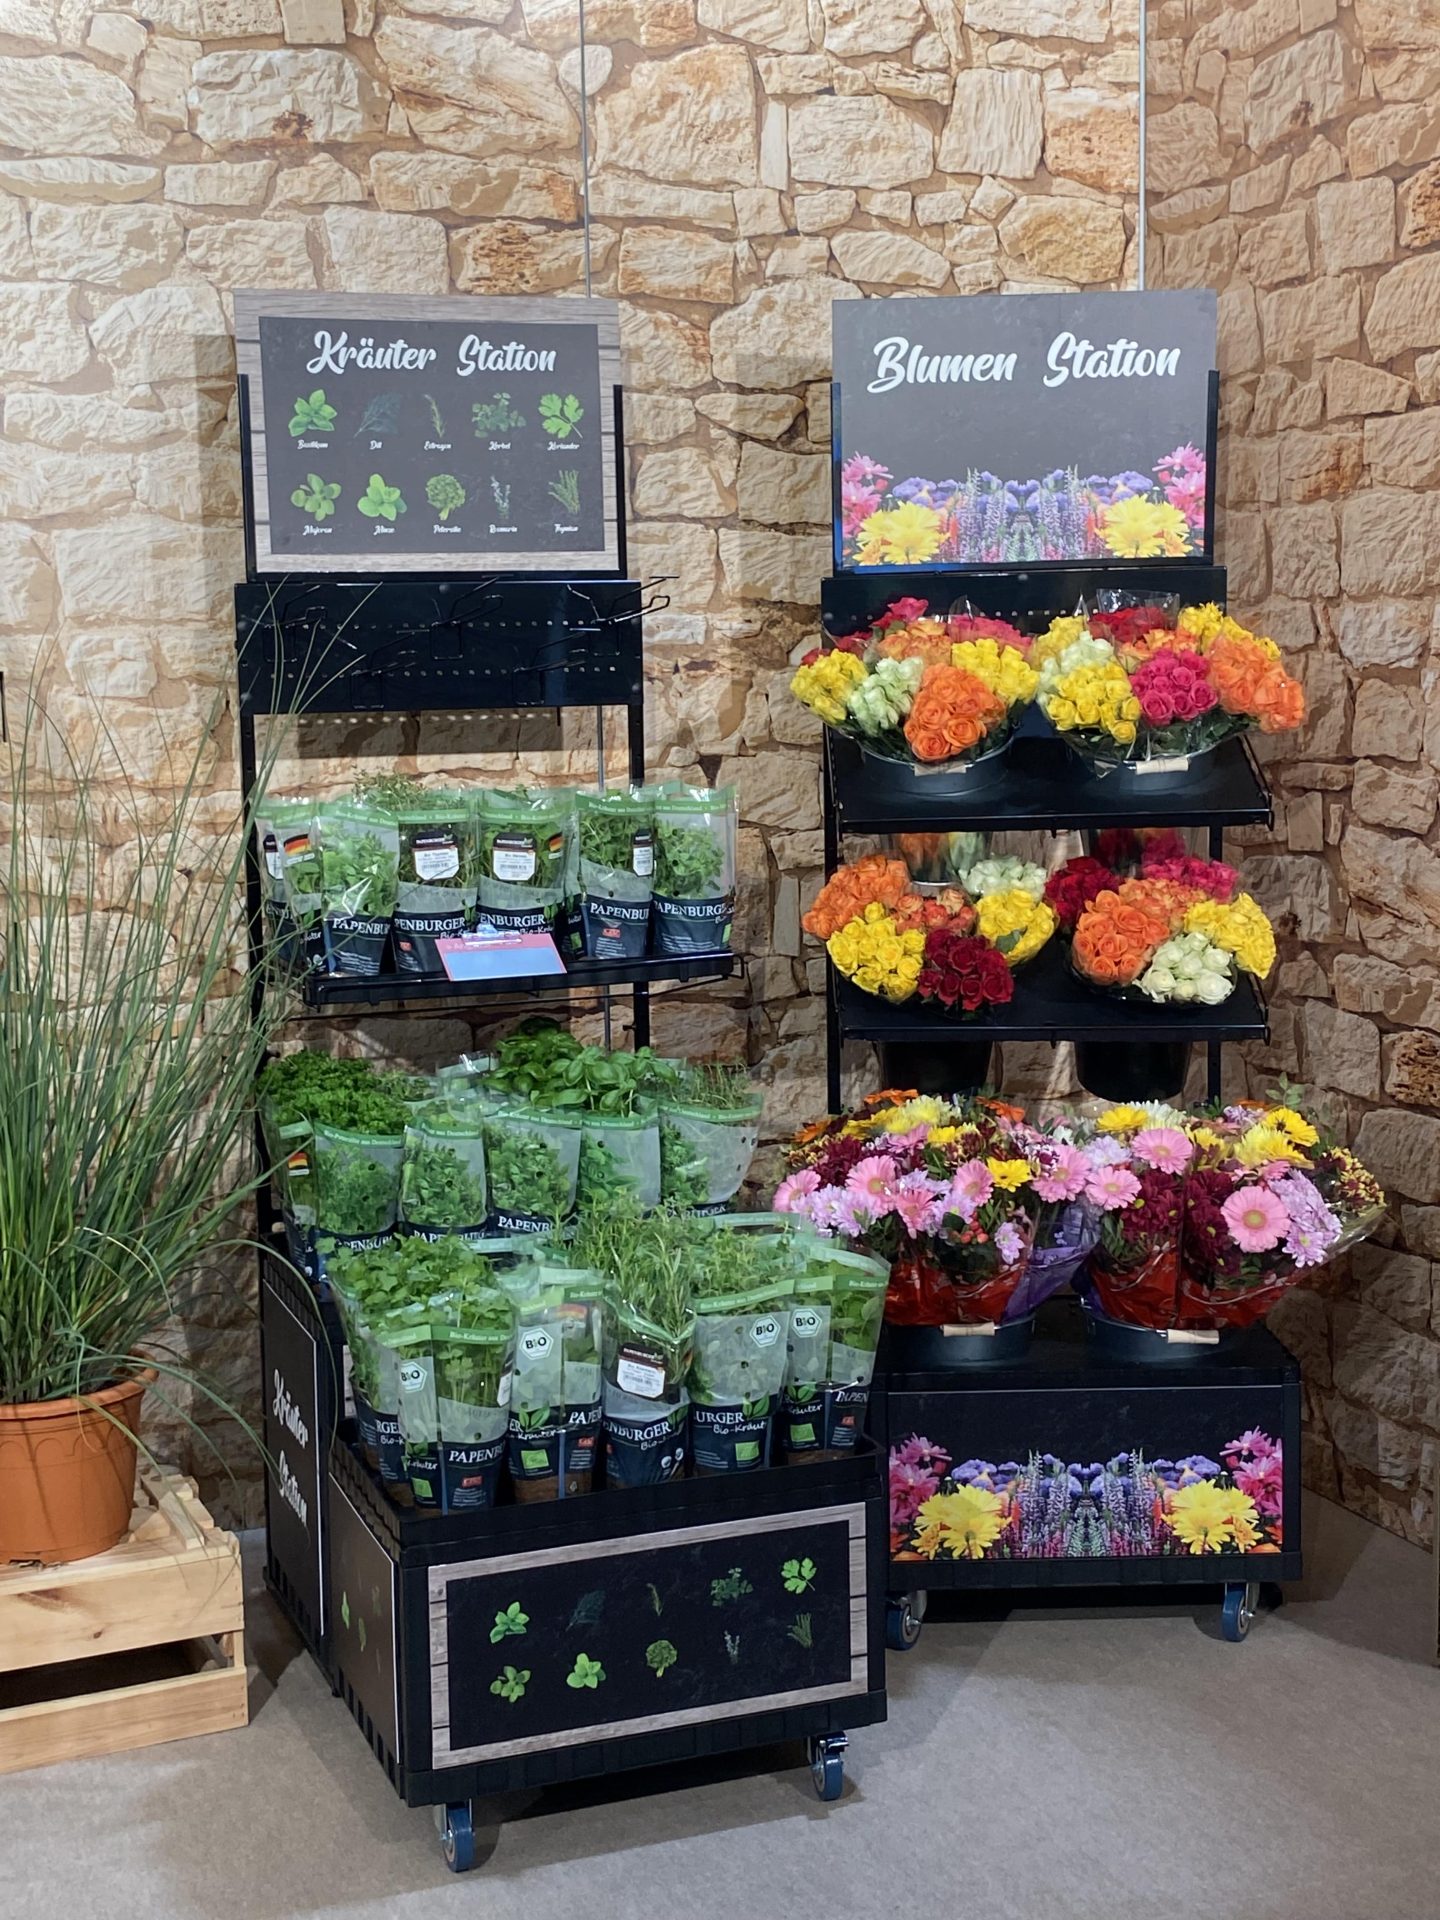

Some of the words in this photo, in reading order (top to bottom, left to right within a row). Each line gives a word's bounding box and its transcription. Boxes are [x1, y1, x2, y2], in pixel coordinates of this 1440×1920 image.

[306, 330, 438, 374] Kräuter
[456, 334, 557, 377] Station
[867, 336, 1018, 394] Blumen
[1043, 331, 1181, 388] Station
